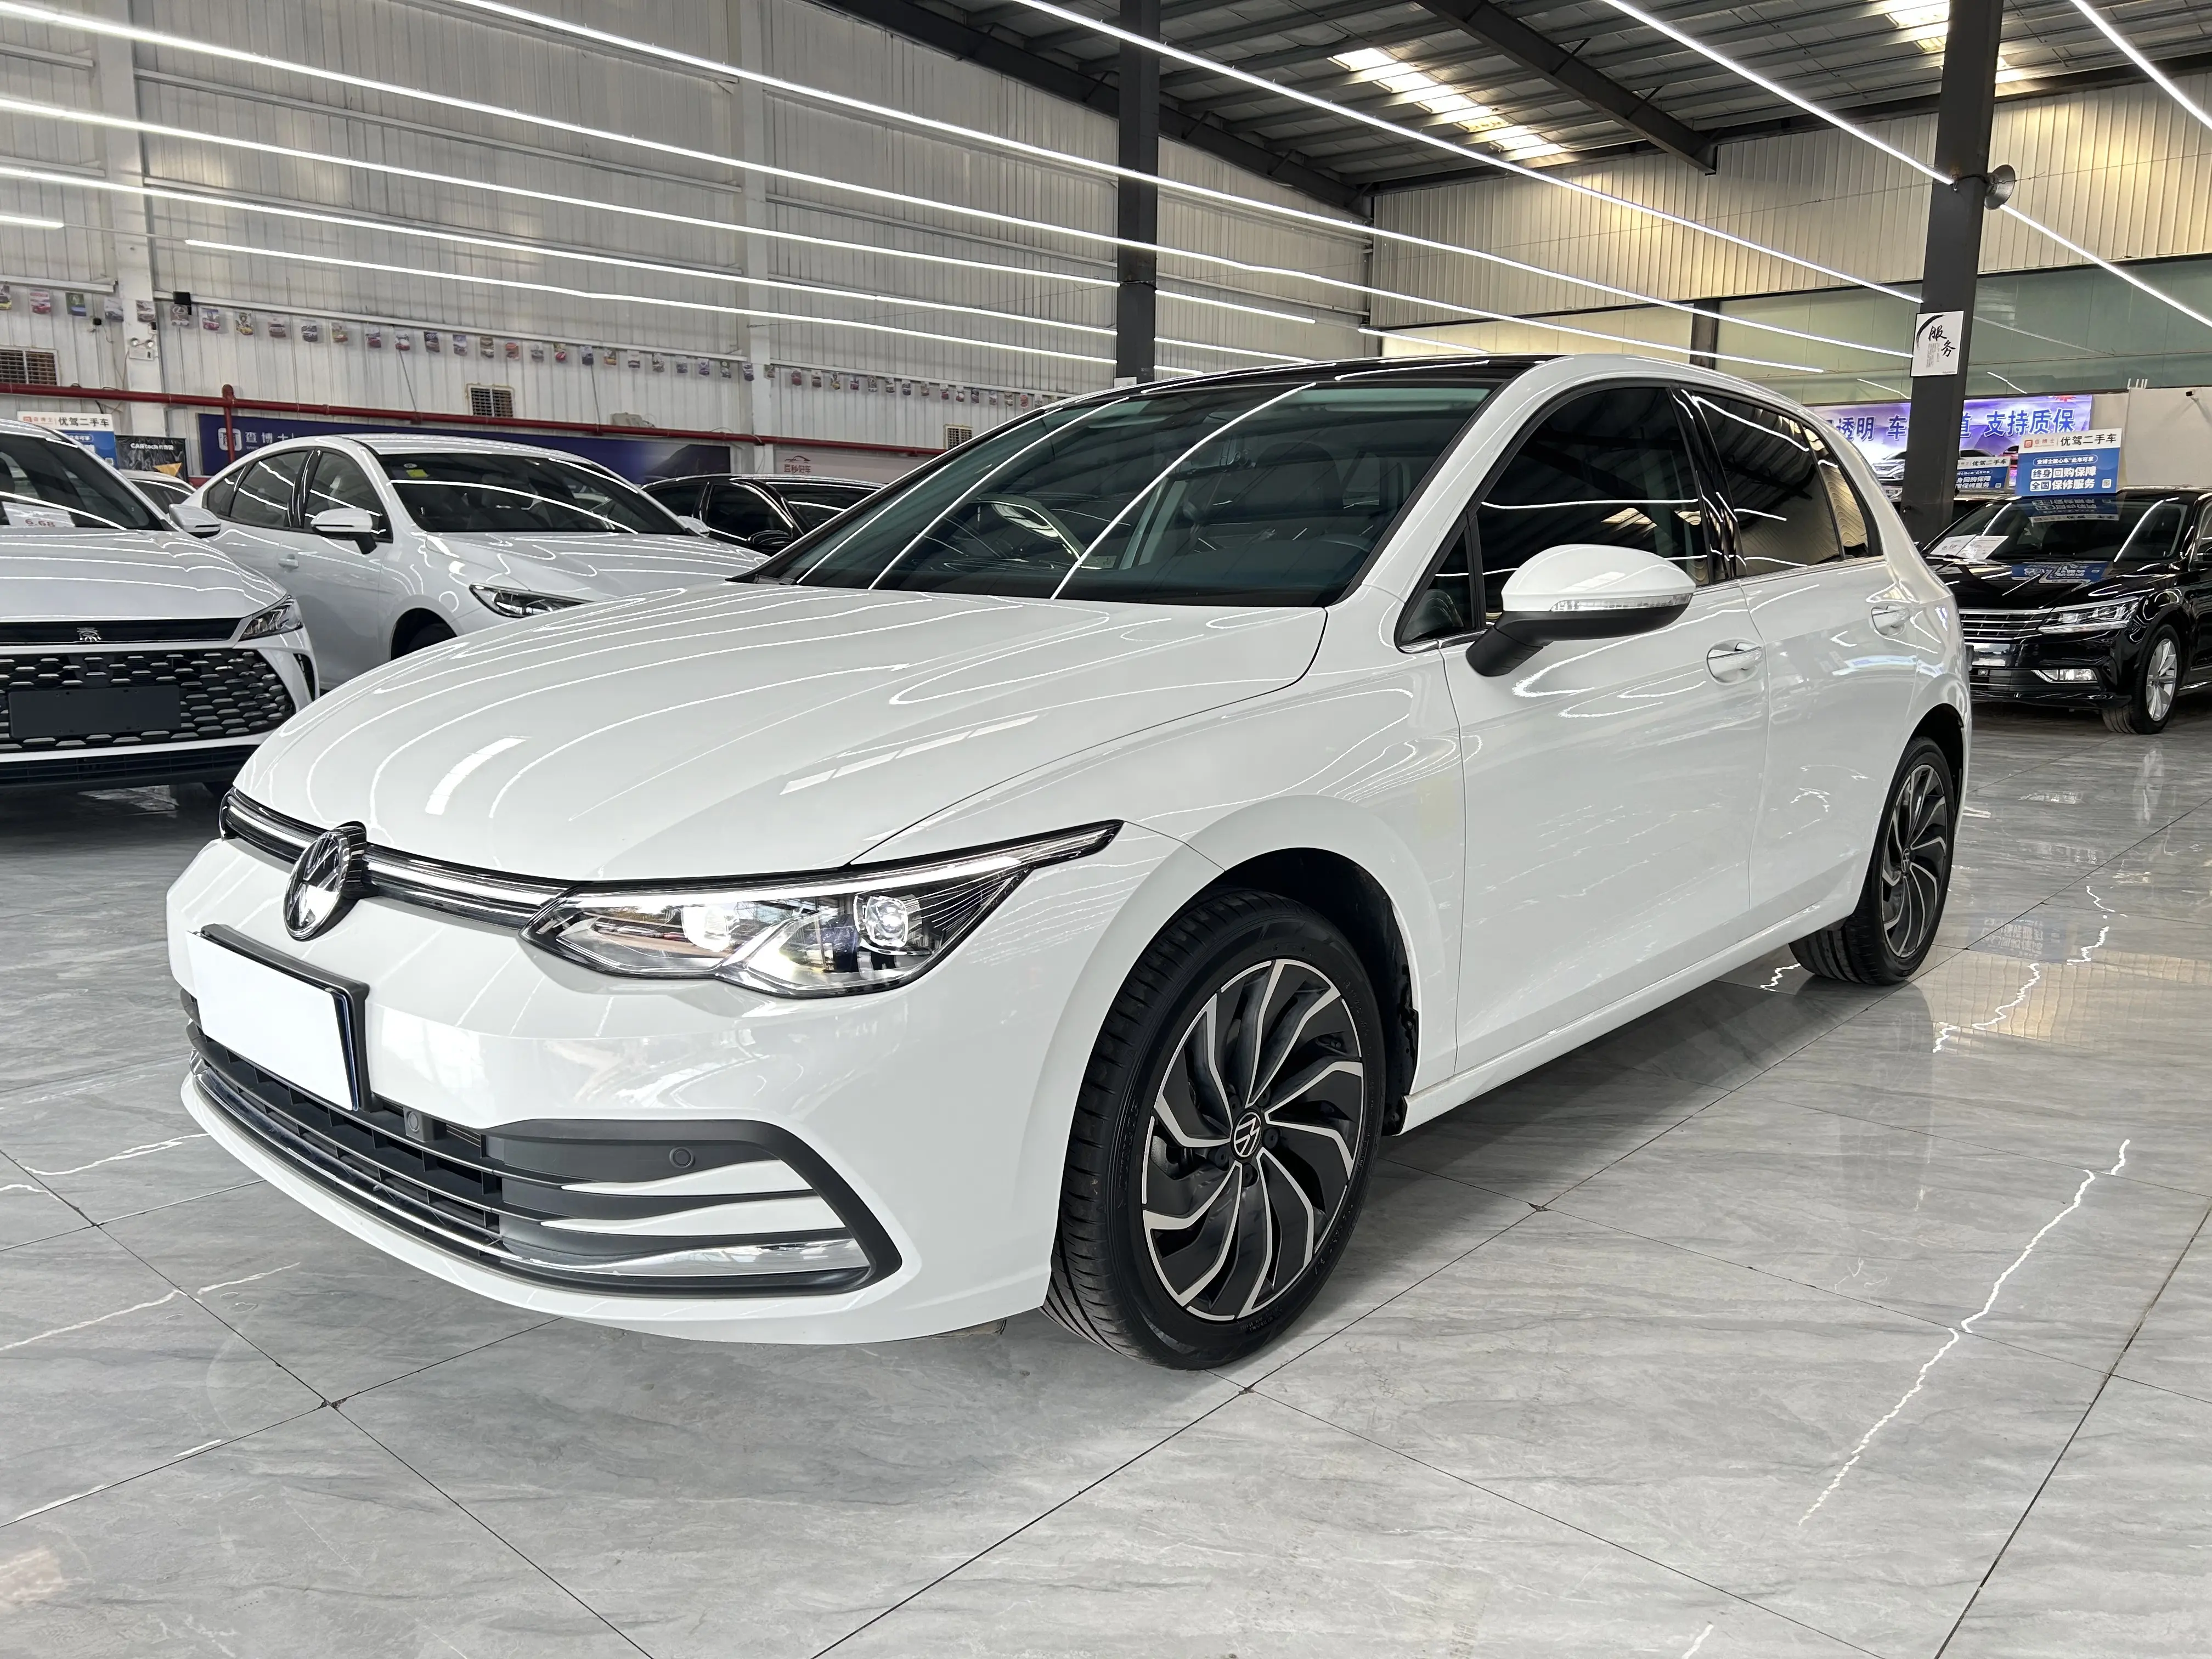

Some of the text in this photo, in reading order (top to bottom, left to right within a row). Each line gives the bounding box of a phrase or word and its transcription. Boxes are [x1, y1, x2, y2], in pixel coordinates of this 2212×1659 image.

[1928, 325, 1956, 358] 服务
[58, 416, 110, 427] 优驾二手车
[1984, 408, 2075, 437] 支持质保
[2061, 433, 2117, 447] 优驾二手车
[2032, 466, 2097, 478] 终身回购保障
[2031, 478, 2096, 491] 全国保修服务
